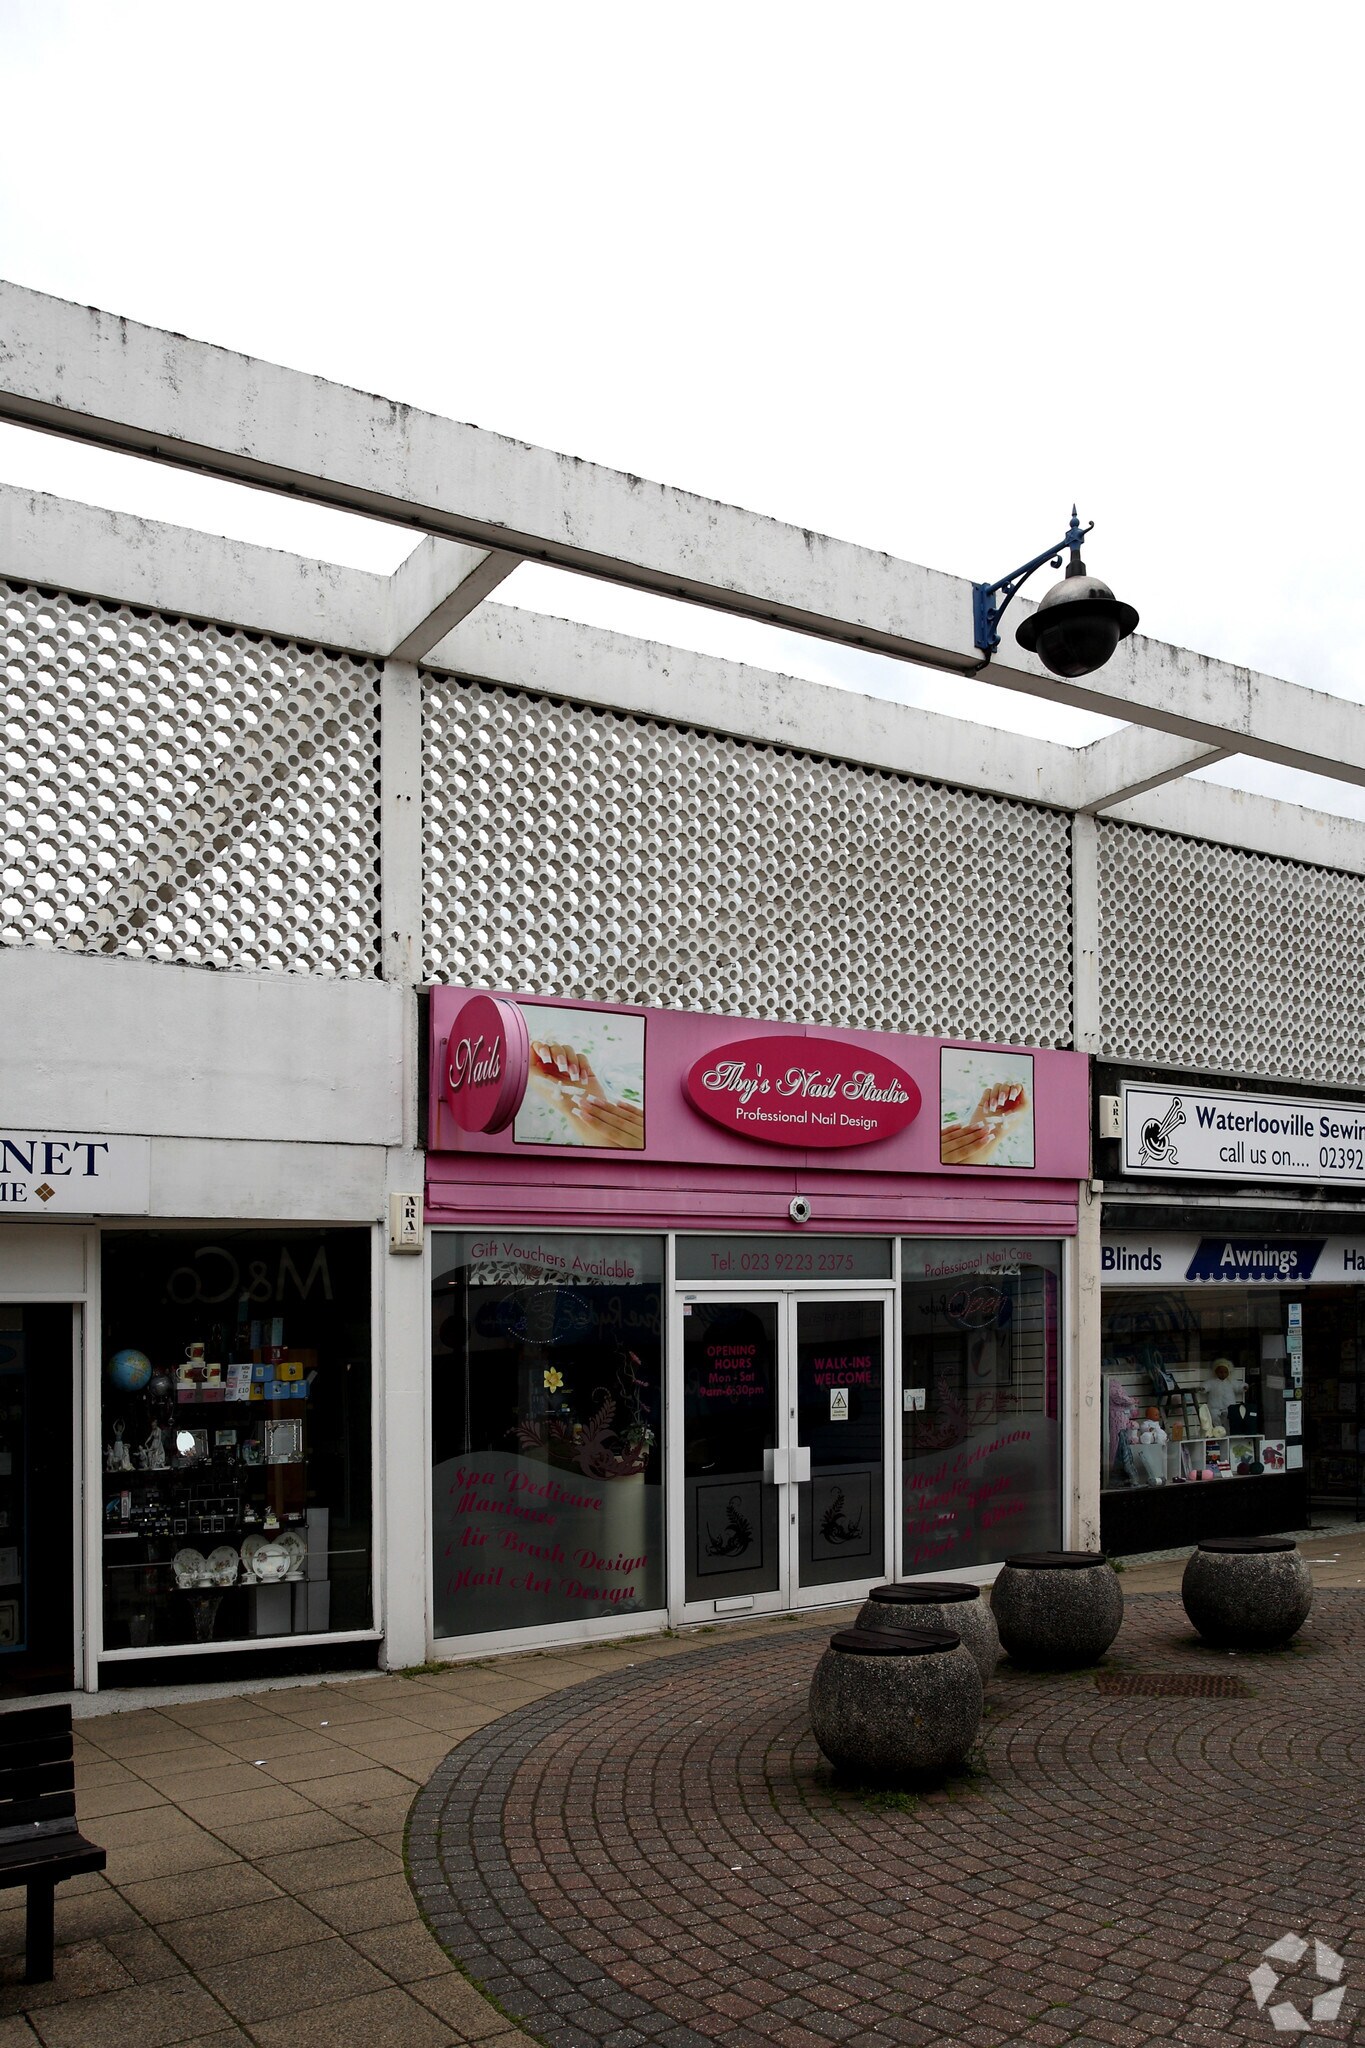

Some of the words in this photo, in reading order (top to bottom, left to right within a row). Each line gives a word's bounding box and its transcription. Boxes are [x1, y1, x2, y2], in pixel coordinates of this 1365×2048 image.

[449, 1035, 501, 1088] Nails
[702, 1061, 771, 1104] Thy's
[775, 1067, 842, 1098] Nail
[842, 1071, 909, 1104] Studio
[736, 1107, 808, 1124] Professional
[811, 1112, 837, 1125] Nail
[840, 1114, 878, 1131] Design
[1195, 1105, 1314, 1137] Waterlooville
[1219, 1141, 1245, 1163] call
[1250, 1149, 1267, 1165] us
[1319, 1146, 1364, 1170] 02392
[405, 1196, 416, 1231] ARA
[471, 1240, 499, 1259] Gift
[502, 1242, 566, 1268] Vouchers
[572, 1255, 635, 1279] Available
[711, 1251, 736, 1271] Tel:
[741, 1253, 770, 1271] 023
[774, 1253, 813, 1271] 9223
[818, 1254, 854, 1271] 2375
[924, 1252, 983, 1278] Professional
[986, 1248, 1007, 1265] Nail
[1009, 1247, 1032, 1261] Care
[1101, 1246, 1163, 1272] Blinds
[1220, 1242, 1298, 1274] Awnings
[706, 1344, 757, 1358] OPENING
[714, 1358, 753, 1370] HOURS
[814, 1356, 872, 1370] WALK-INS
[708, 1371, 732, 1383] Mon
[813, 1371, 872, 1386] WELCOME
[449, 1466, 497, 1495] Spa
[449, 1491, 558, 1526] Manicure
[445, 1526, 488, 1557] Air
[498, 1529, 566, 1565] Brush
[573, 1548, 648, 1575] Design
[446, 1566, 504, 1598] Nail
[560, 1578, 635, 1604] Design
